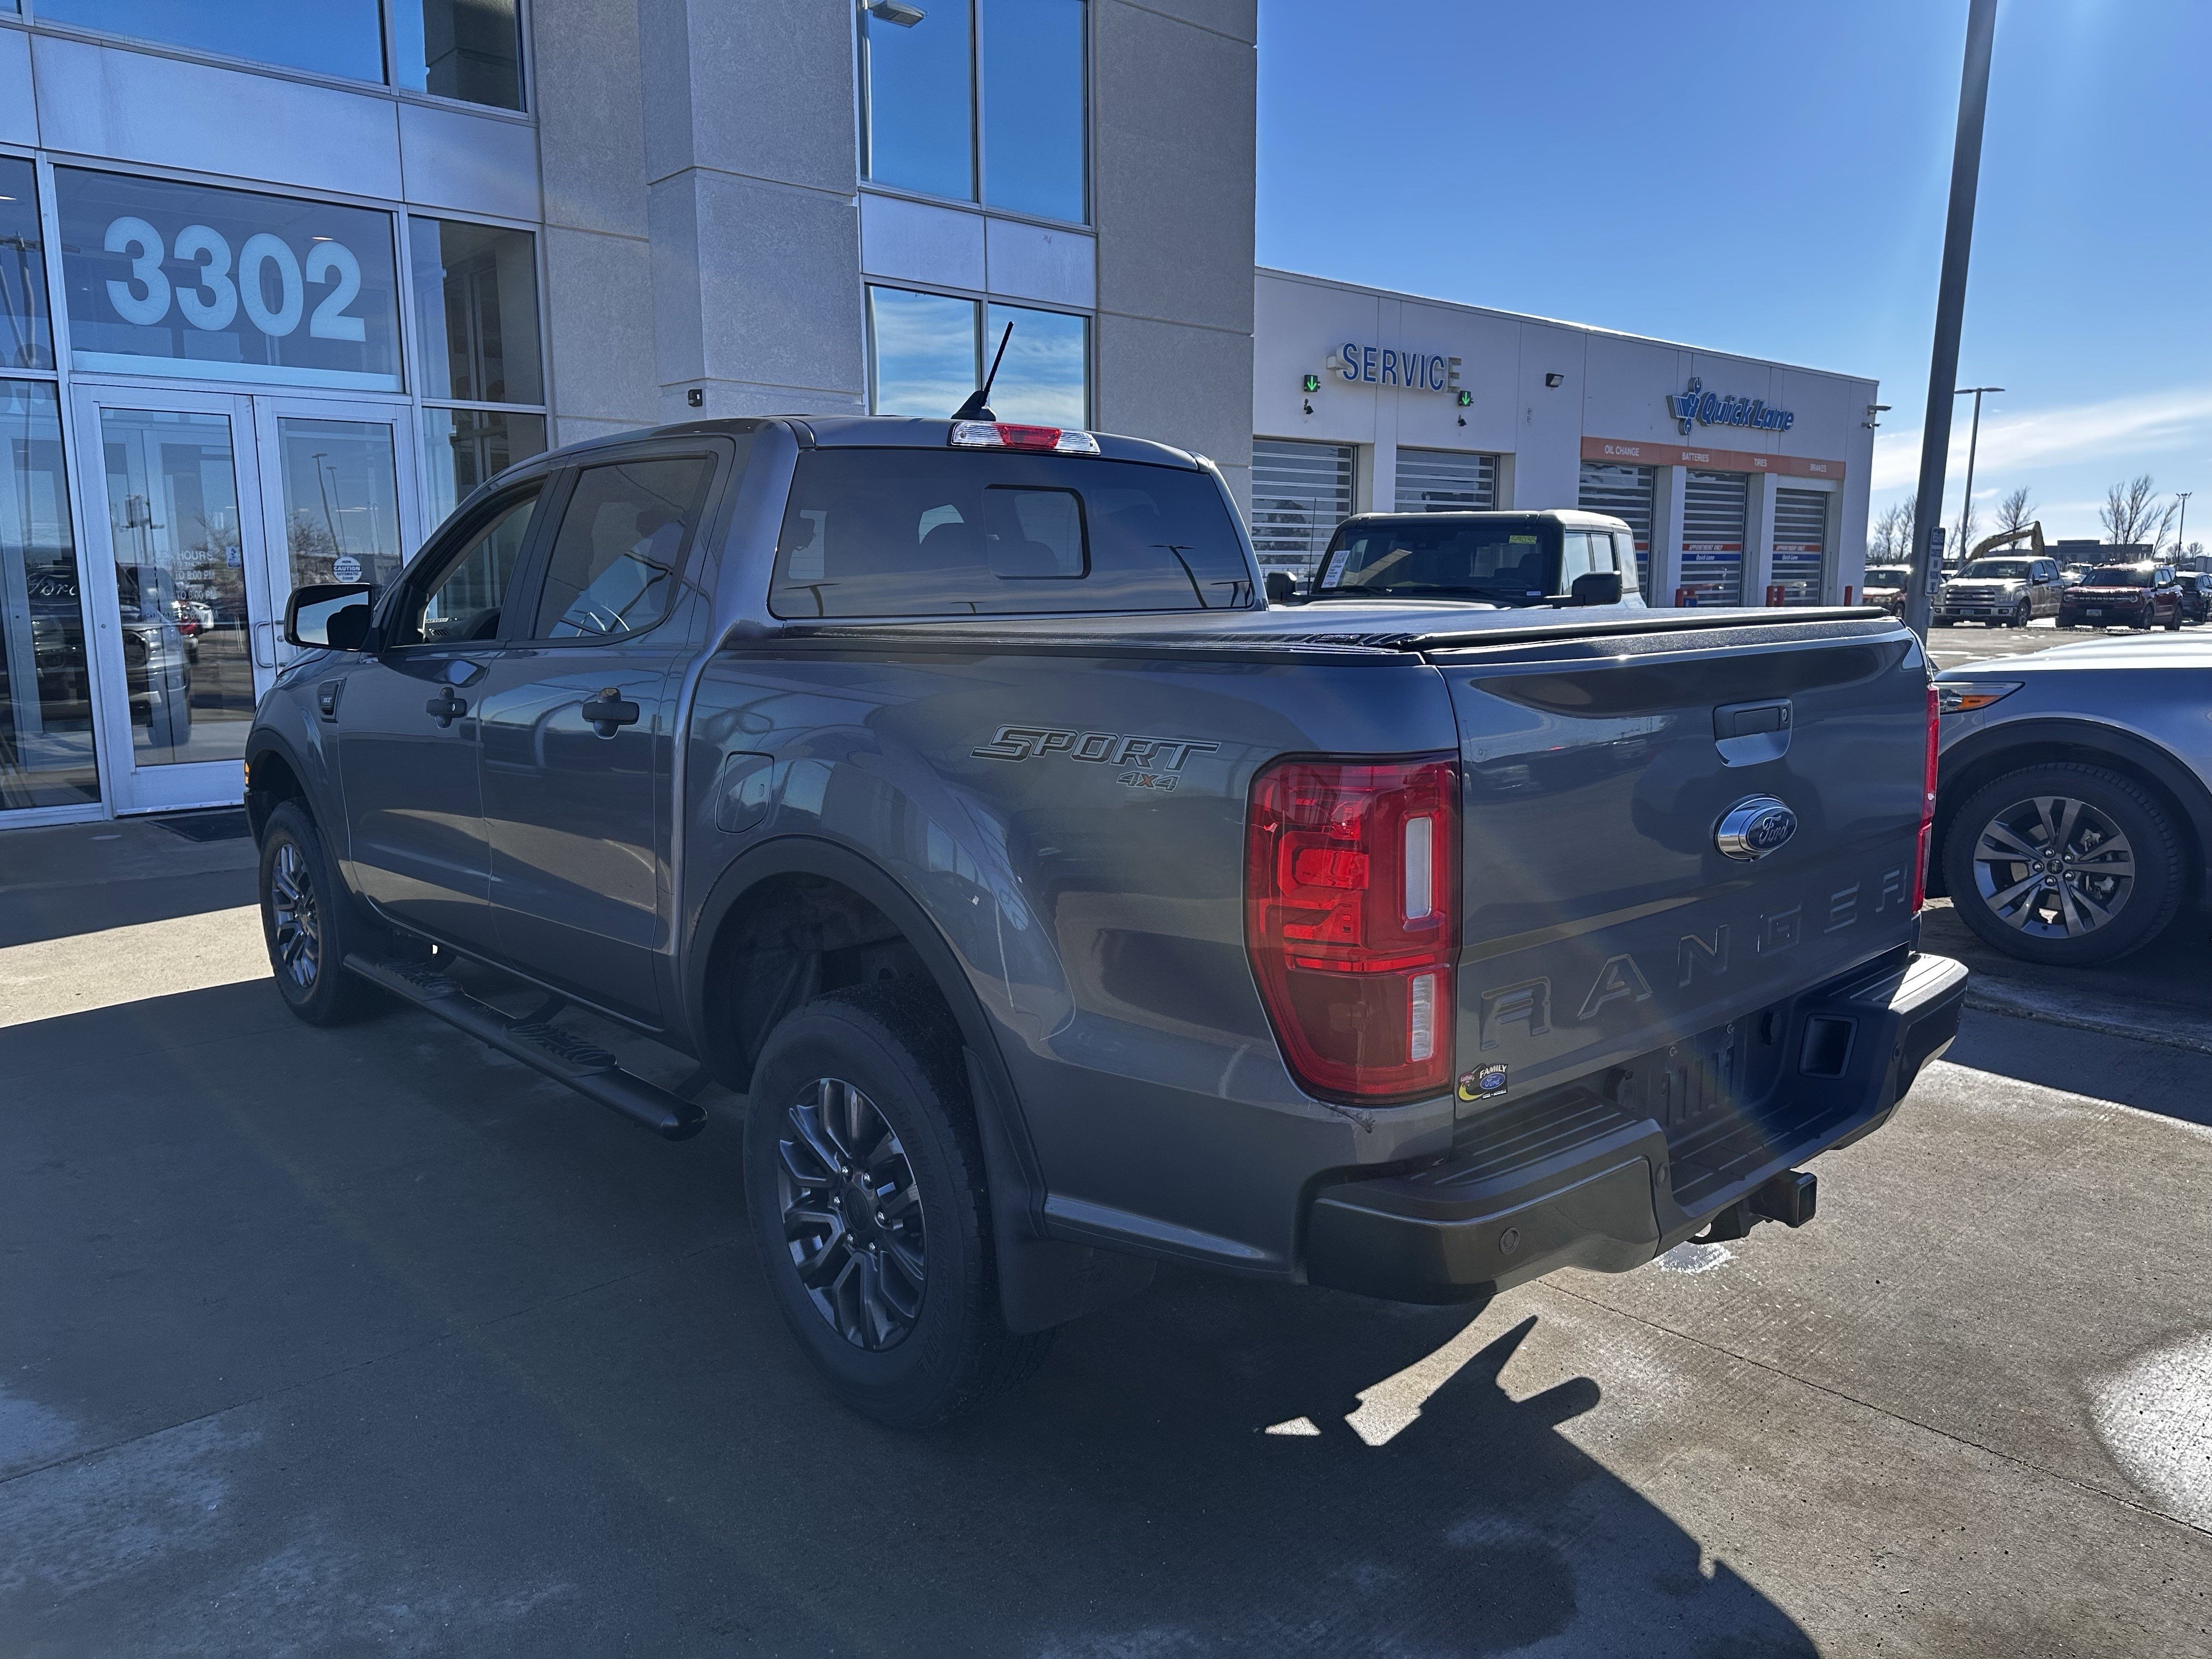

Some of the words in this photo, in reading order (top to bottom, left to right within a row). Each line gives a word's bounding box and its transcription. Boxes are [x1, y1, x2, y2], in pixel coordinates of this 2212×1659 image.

[104, 217, 365, 342] 3302
[1342, 342, 1462, 393] SERVICE
[1701, 392, 1753, 426] Quick
[1751, 399, 1795, 431] Lane
[1605, 444, 1615, 454] OIL
[1616, 446, 1640, 457] CHANGE
[1681, 452, 1709, 462] BATTERIES
[1754, 458, 1768, 467] TIRES
[177, 550, 213, 561] HOURS
[174, 571, 185, 580] TO
[187, 571, 202, 580] 8:00
[176, 590, 187, 600] TO
[970, 724, 1222, 772] SPORT
[1758, 815, 1790, 845] Ford
[1480, 862, 1908, 1052] RANGER
[1480, 1064, 1508, 1080] FAMILY
[1485, 1075, 1501, 1088] Ford
